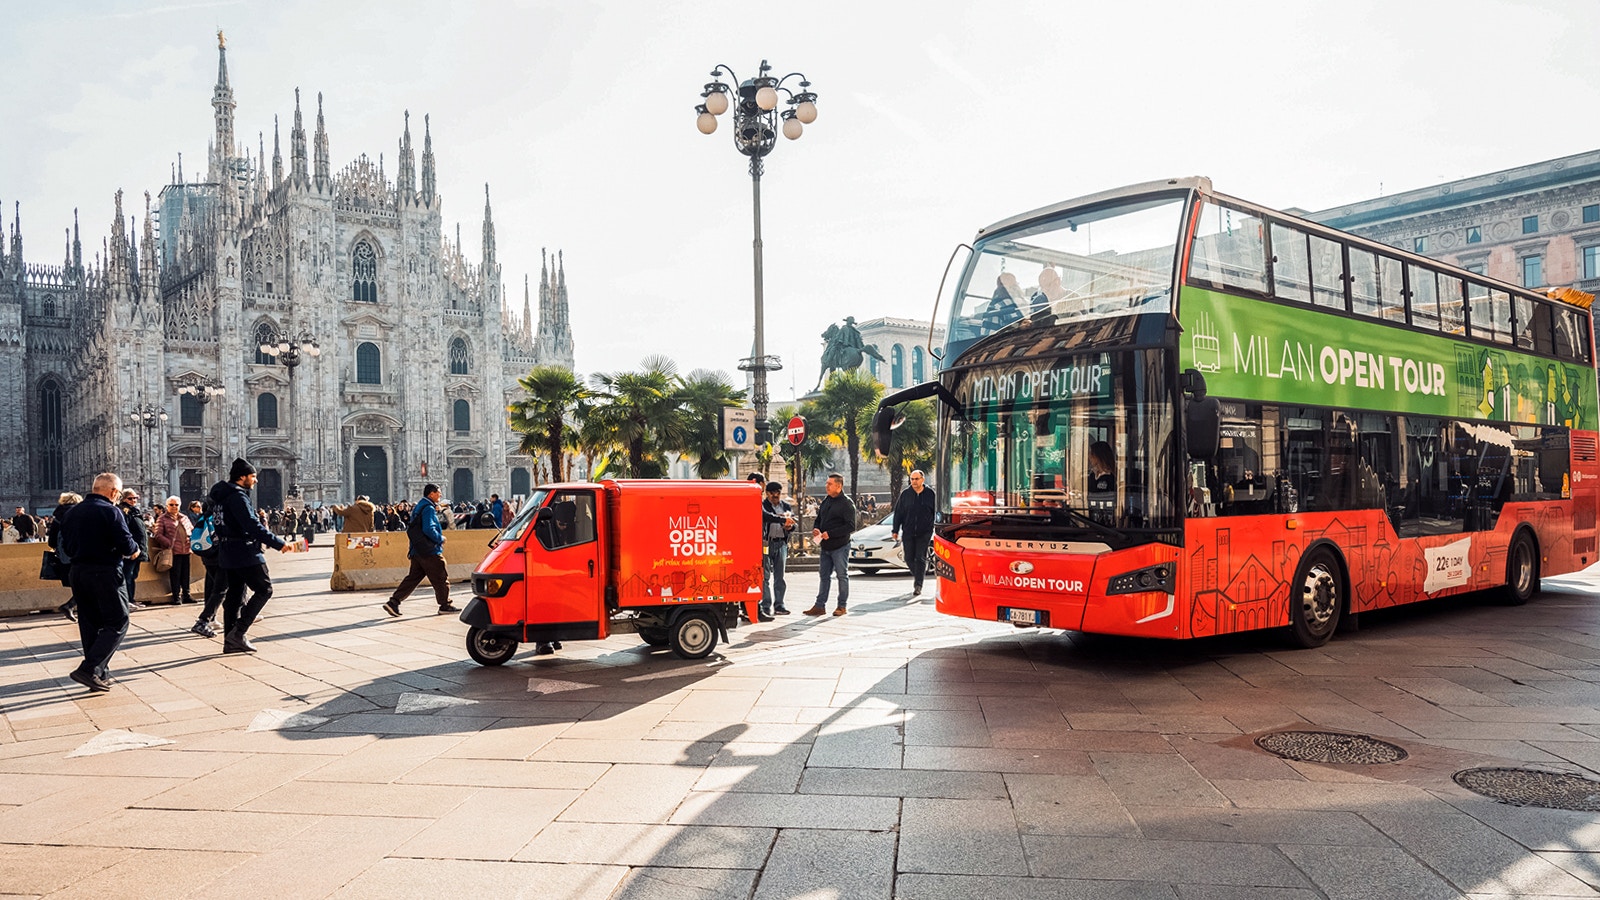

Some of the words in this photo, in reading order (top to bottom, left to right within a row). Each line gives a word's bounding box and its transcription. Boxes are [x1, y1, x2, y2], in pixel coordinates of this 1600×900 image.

[1232, 332, 1315, 382] MILAN
[1319, 346, 1384, 389] OPEN
[1389, 356, 1446, 397] TOUR
[973, 374, 1016, 402] MILAN
[669, 516, 718, 529] MILAN
[669, 529, 718, 543] OPEN
[670, 543, 717, 557] TOUR
[982, 574, 1013, 586] MILAN
[1013, 576, 1046, 589] OPEN
[1048, 579, 1083, 592] TOUR
